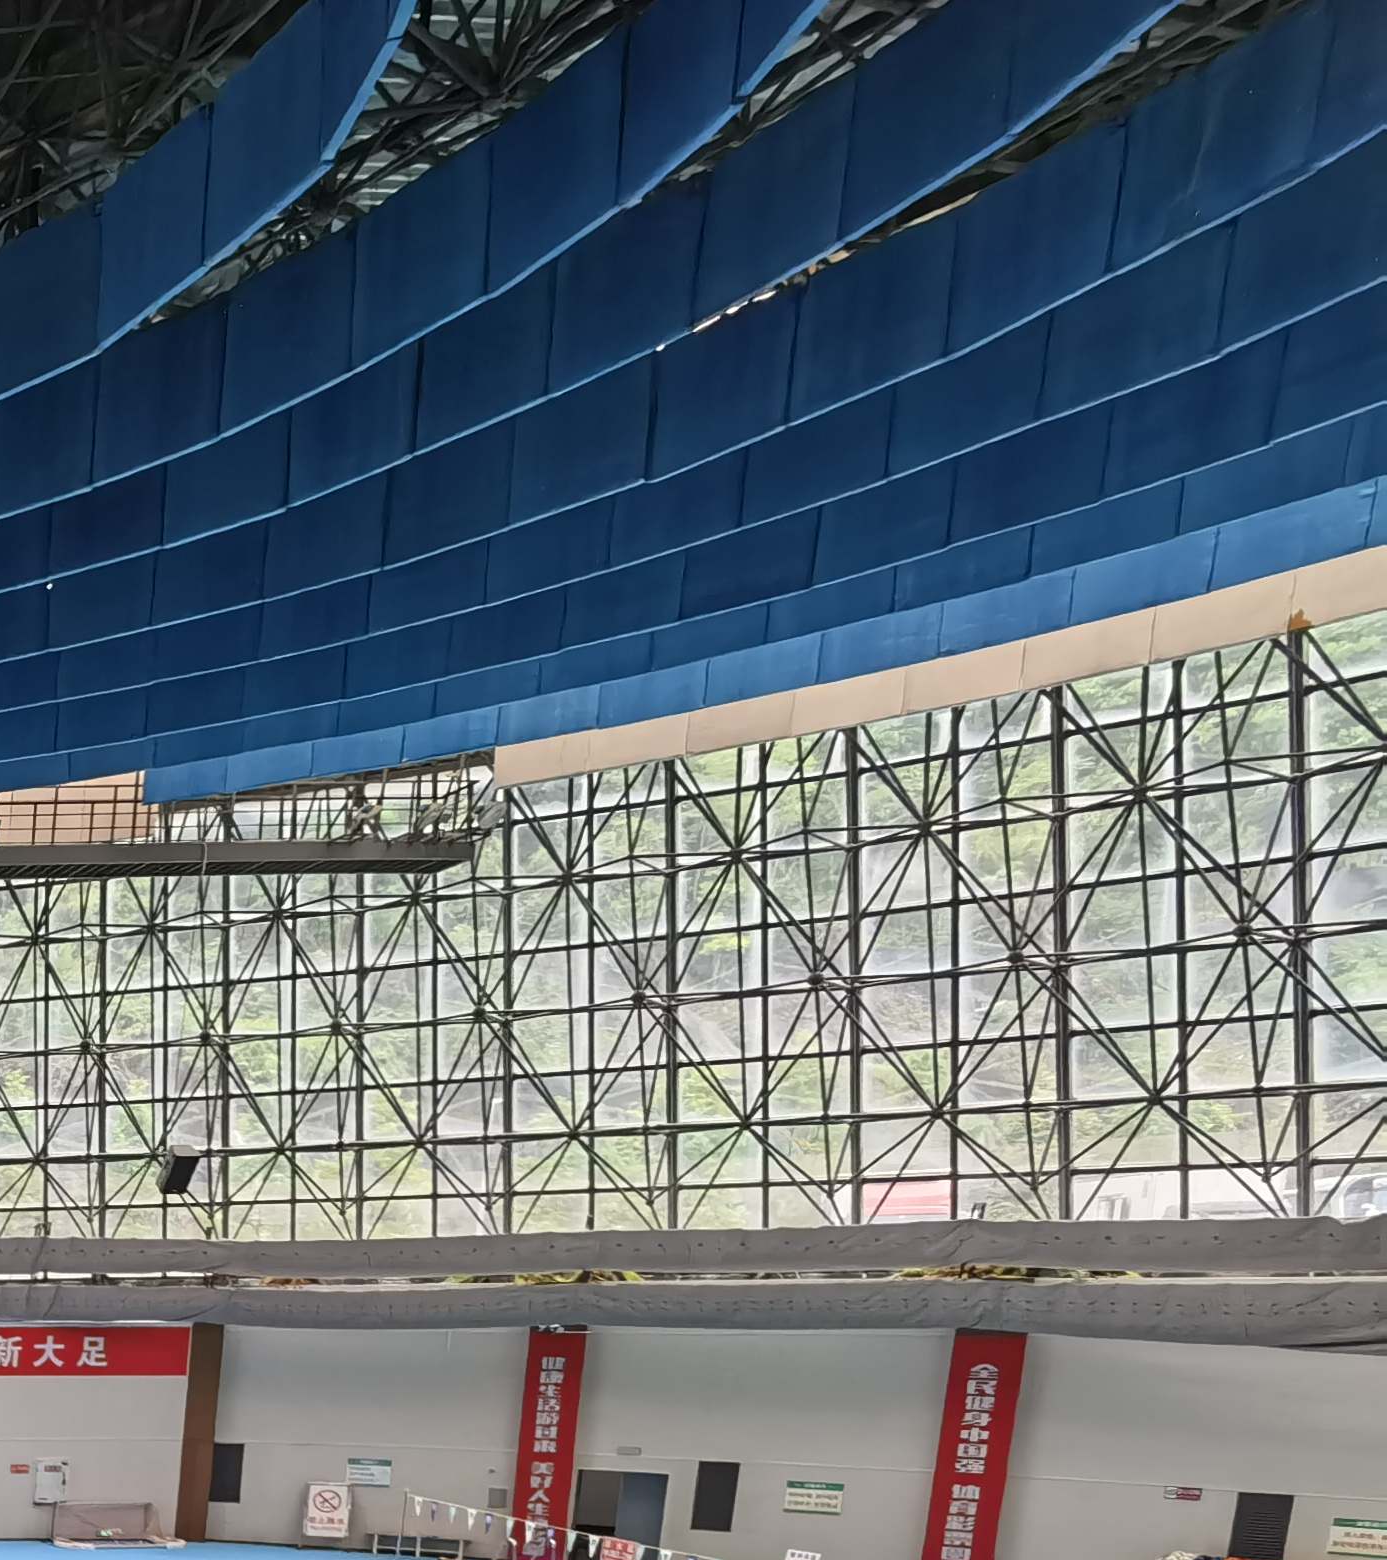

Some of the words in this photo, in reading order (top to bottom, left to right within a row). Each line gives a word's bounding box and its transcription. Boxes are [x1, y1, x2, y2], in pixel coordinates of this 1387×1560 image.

[954, 1362, 1000, 1475] 全民健身中国强
